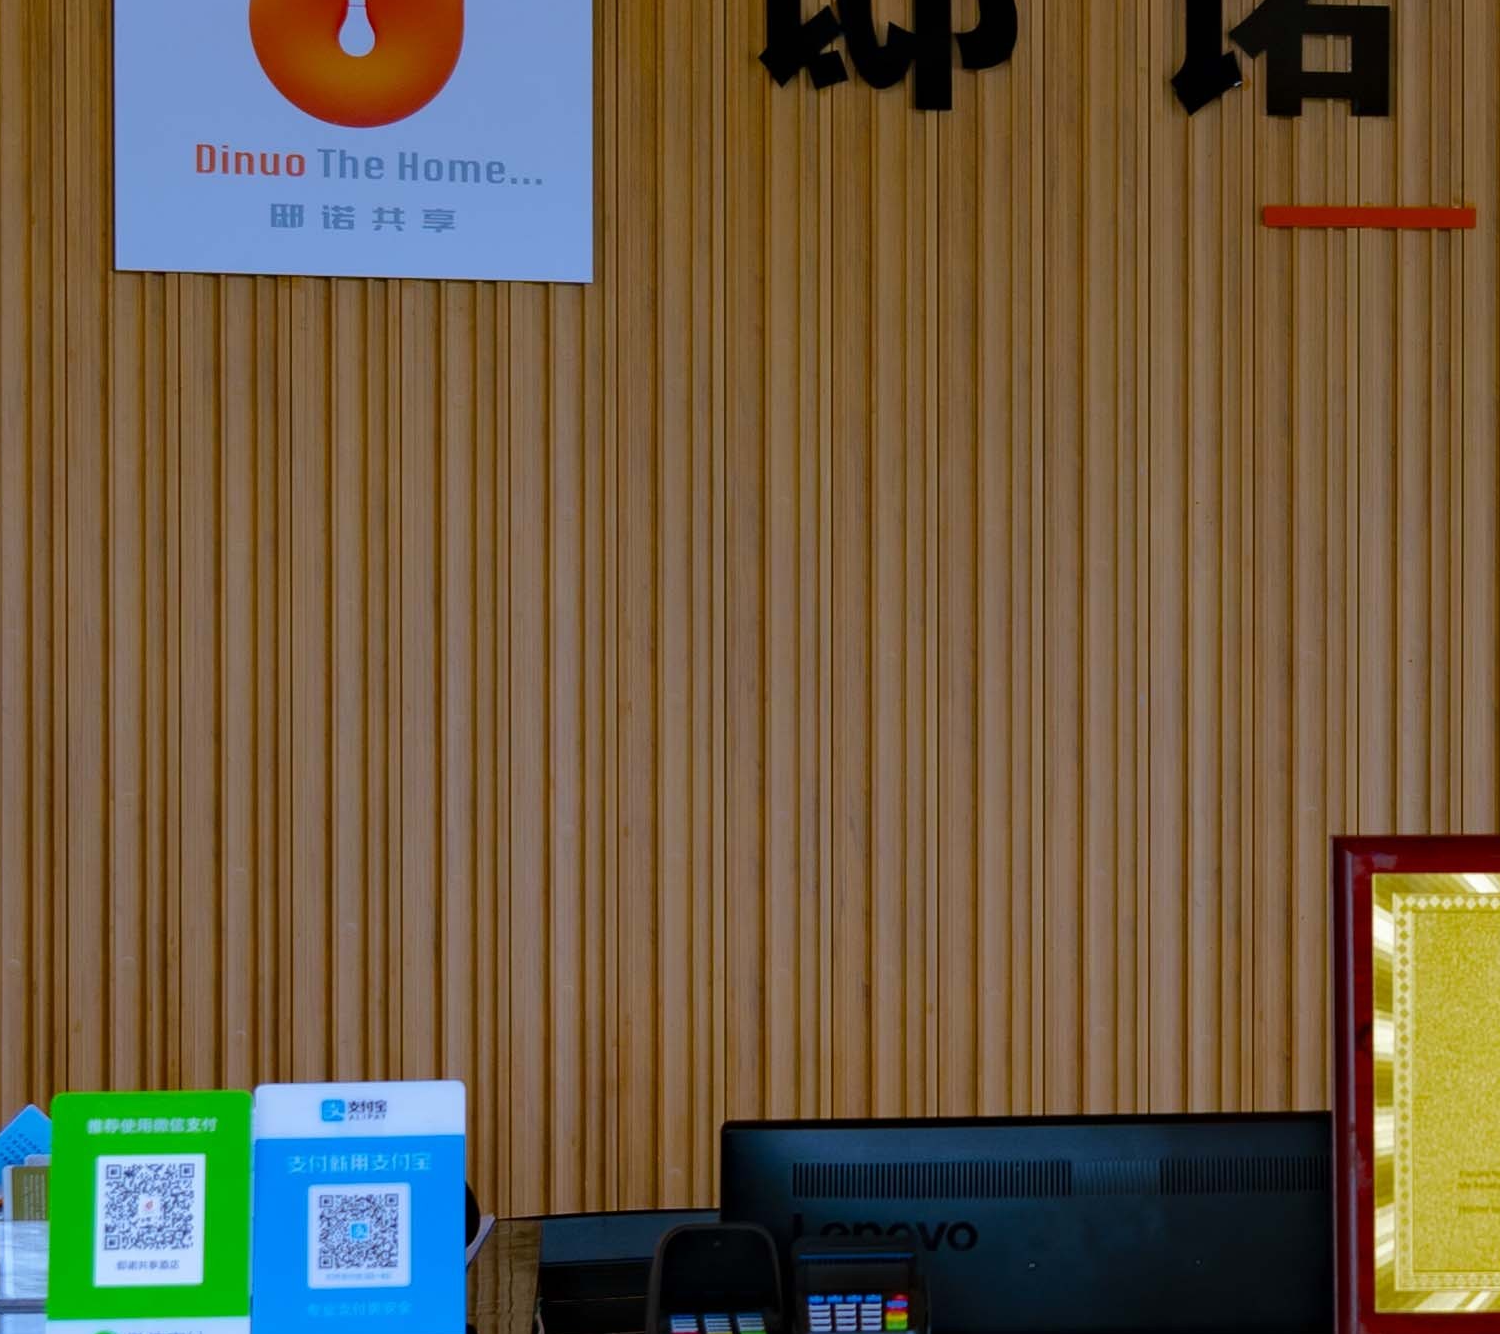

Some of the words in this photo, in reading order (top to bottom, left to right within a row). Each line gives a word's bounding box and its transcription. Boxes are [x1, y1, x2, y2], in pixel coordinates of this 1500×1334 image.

[195, 143, 306, 177] Dinuo
[317, 148, 385, 180] The
[348, 1098, 388, 1114] 支付宝
[286, 1152, 432, 1175] 支付就用支付宝
